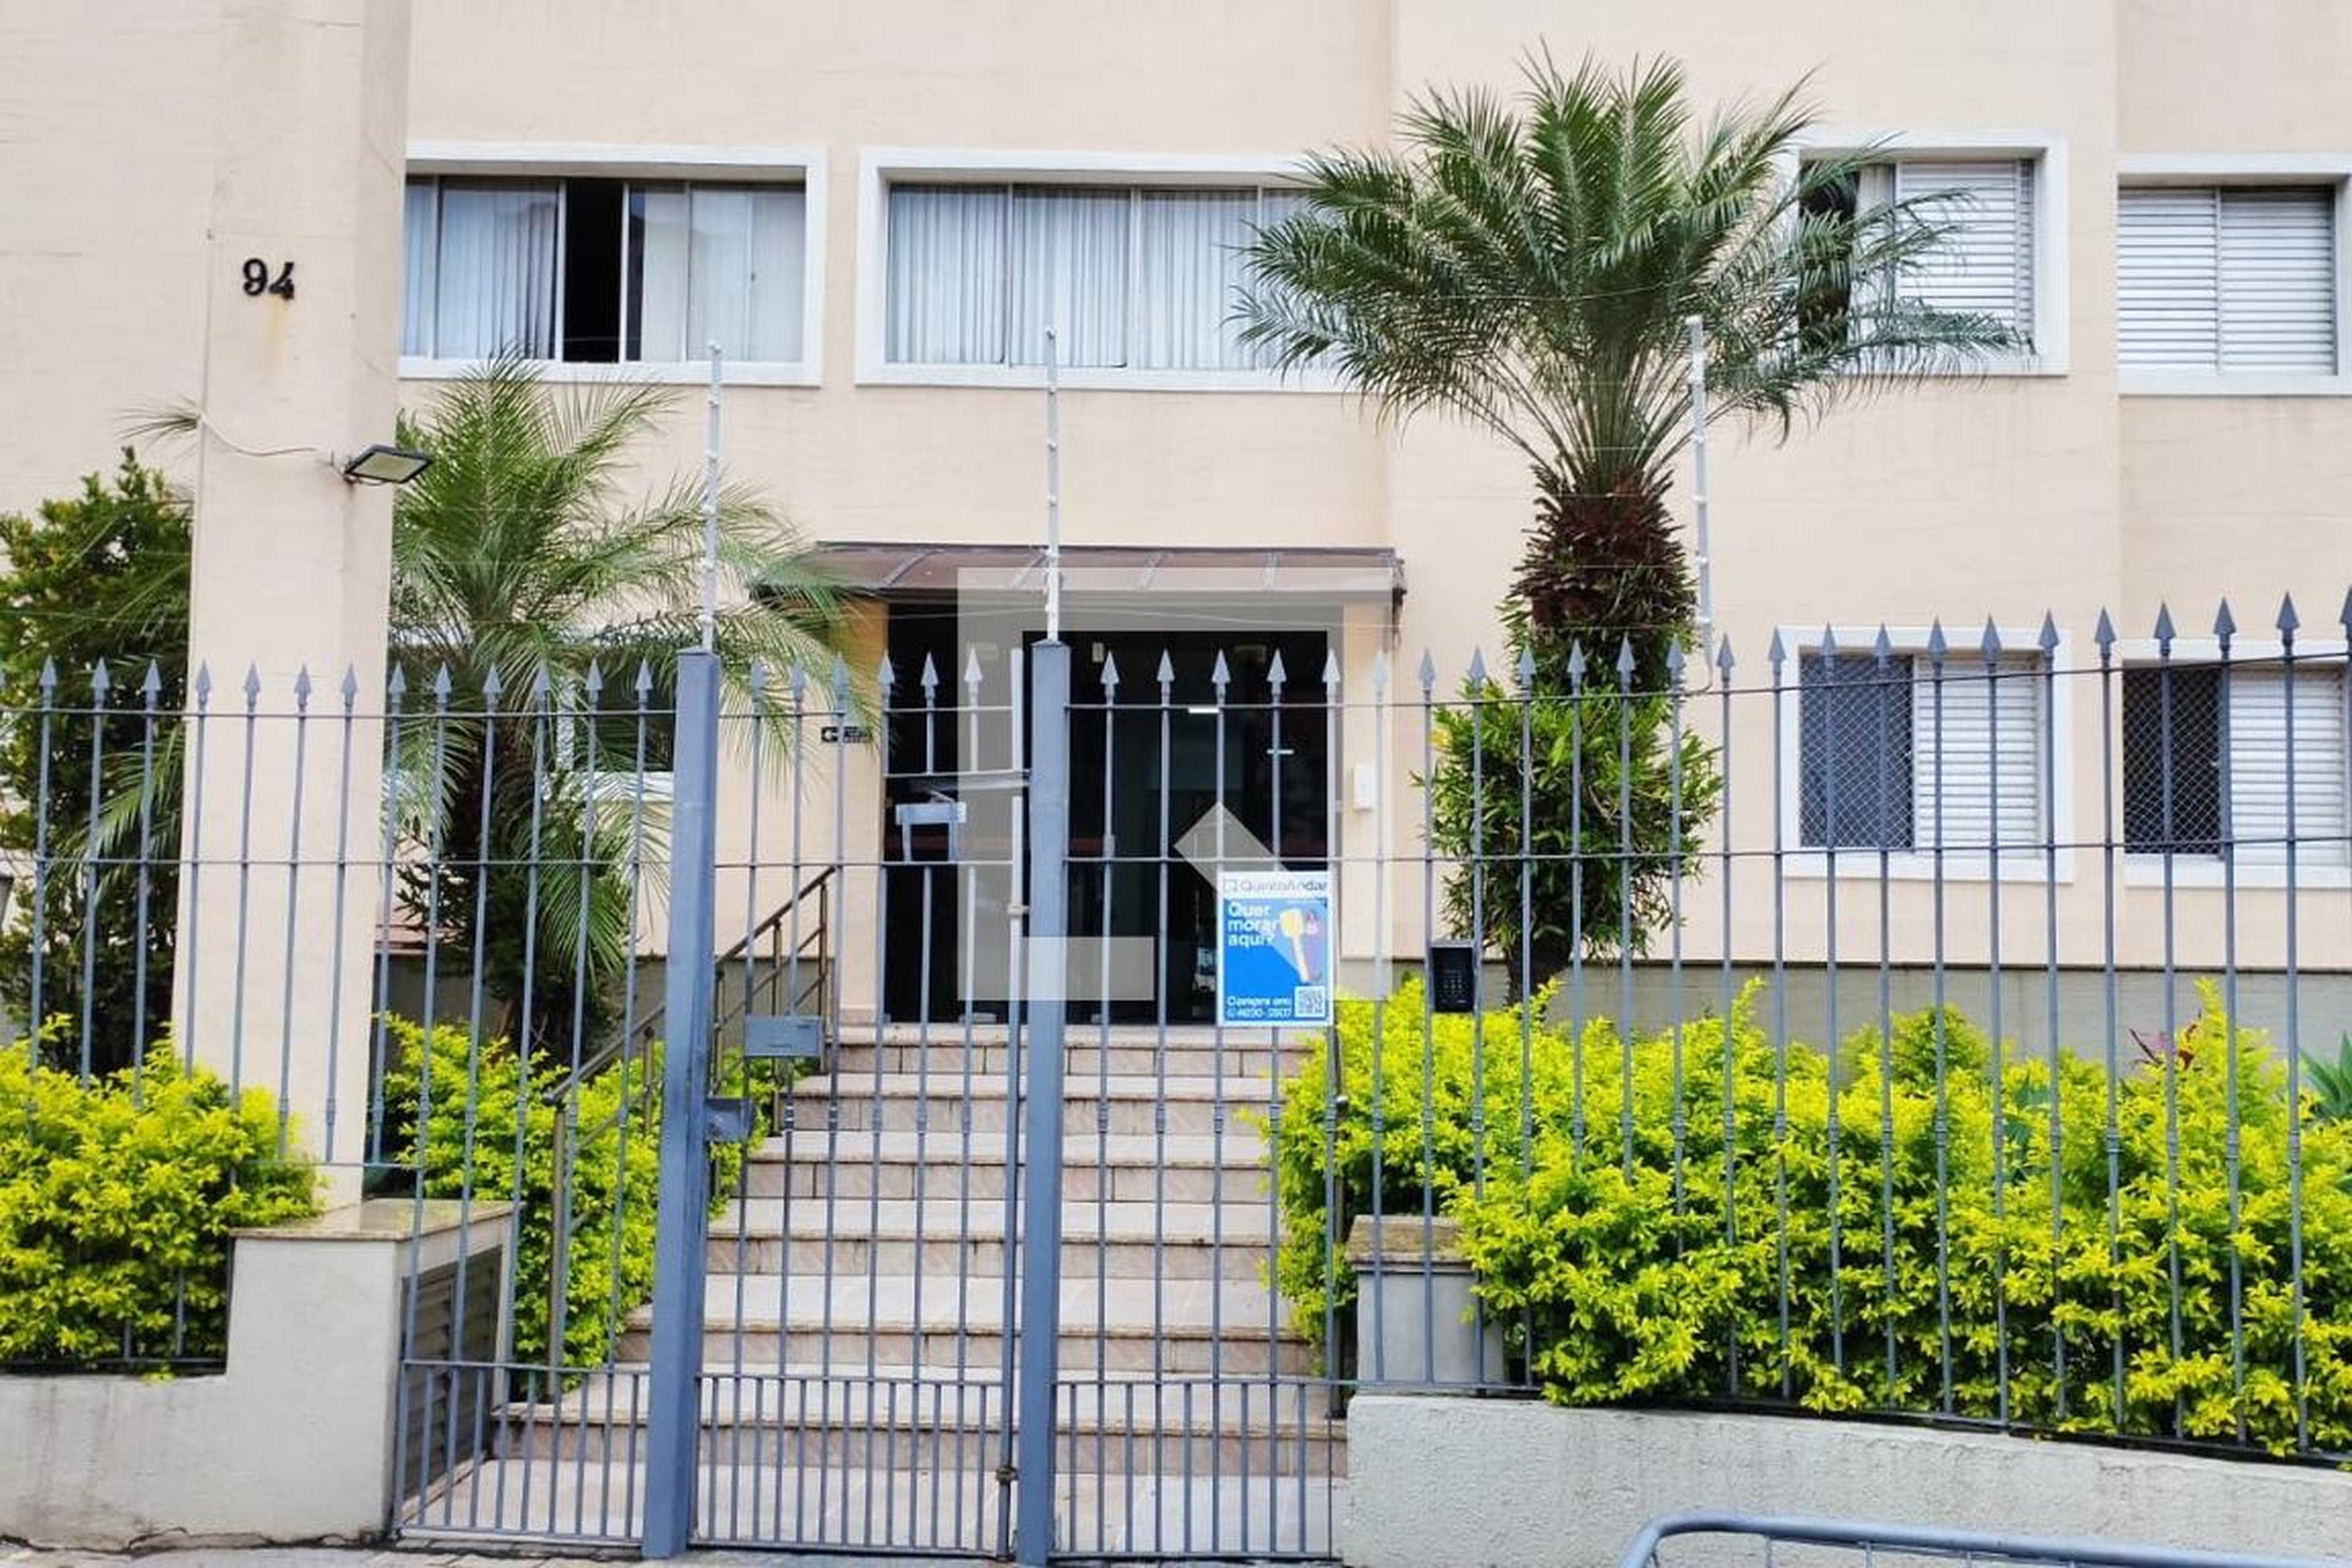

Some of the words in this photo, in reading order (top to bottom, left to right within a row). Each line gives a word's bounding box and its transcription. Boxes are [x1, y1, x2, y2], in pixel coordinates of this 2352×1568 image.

[243, 258, 295, 300] 94
[1227, 901, 1272, 918] Quer
[1227, 919, 1277, 932] morar
